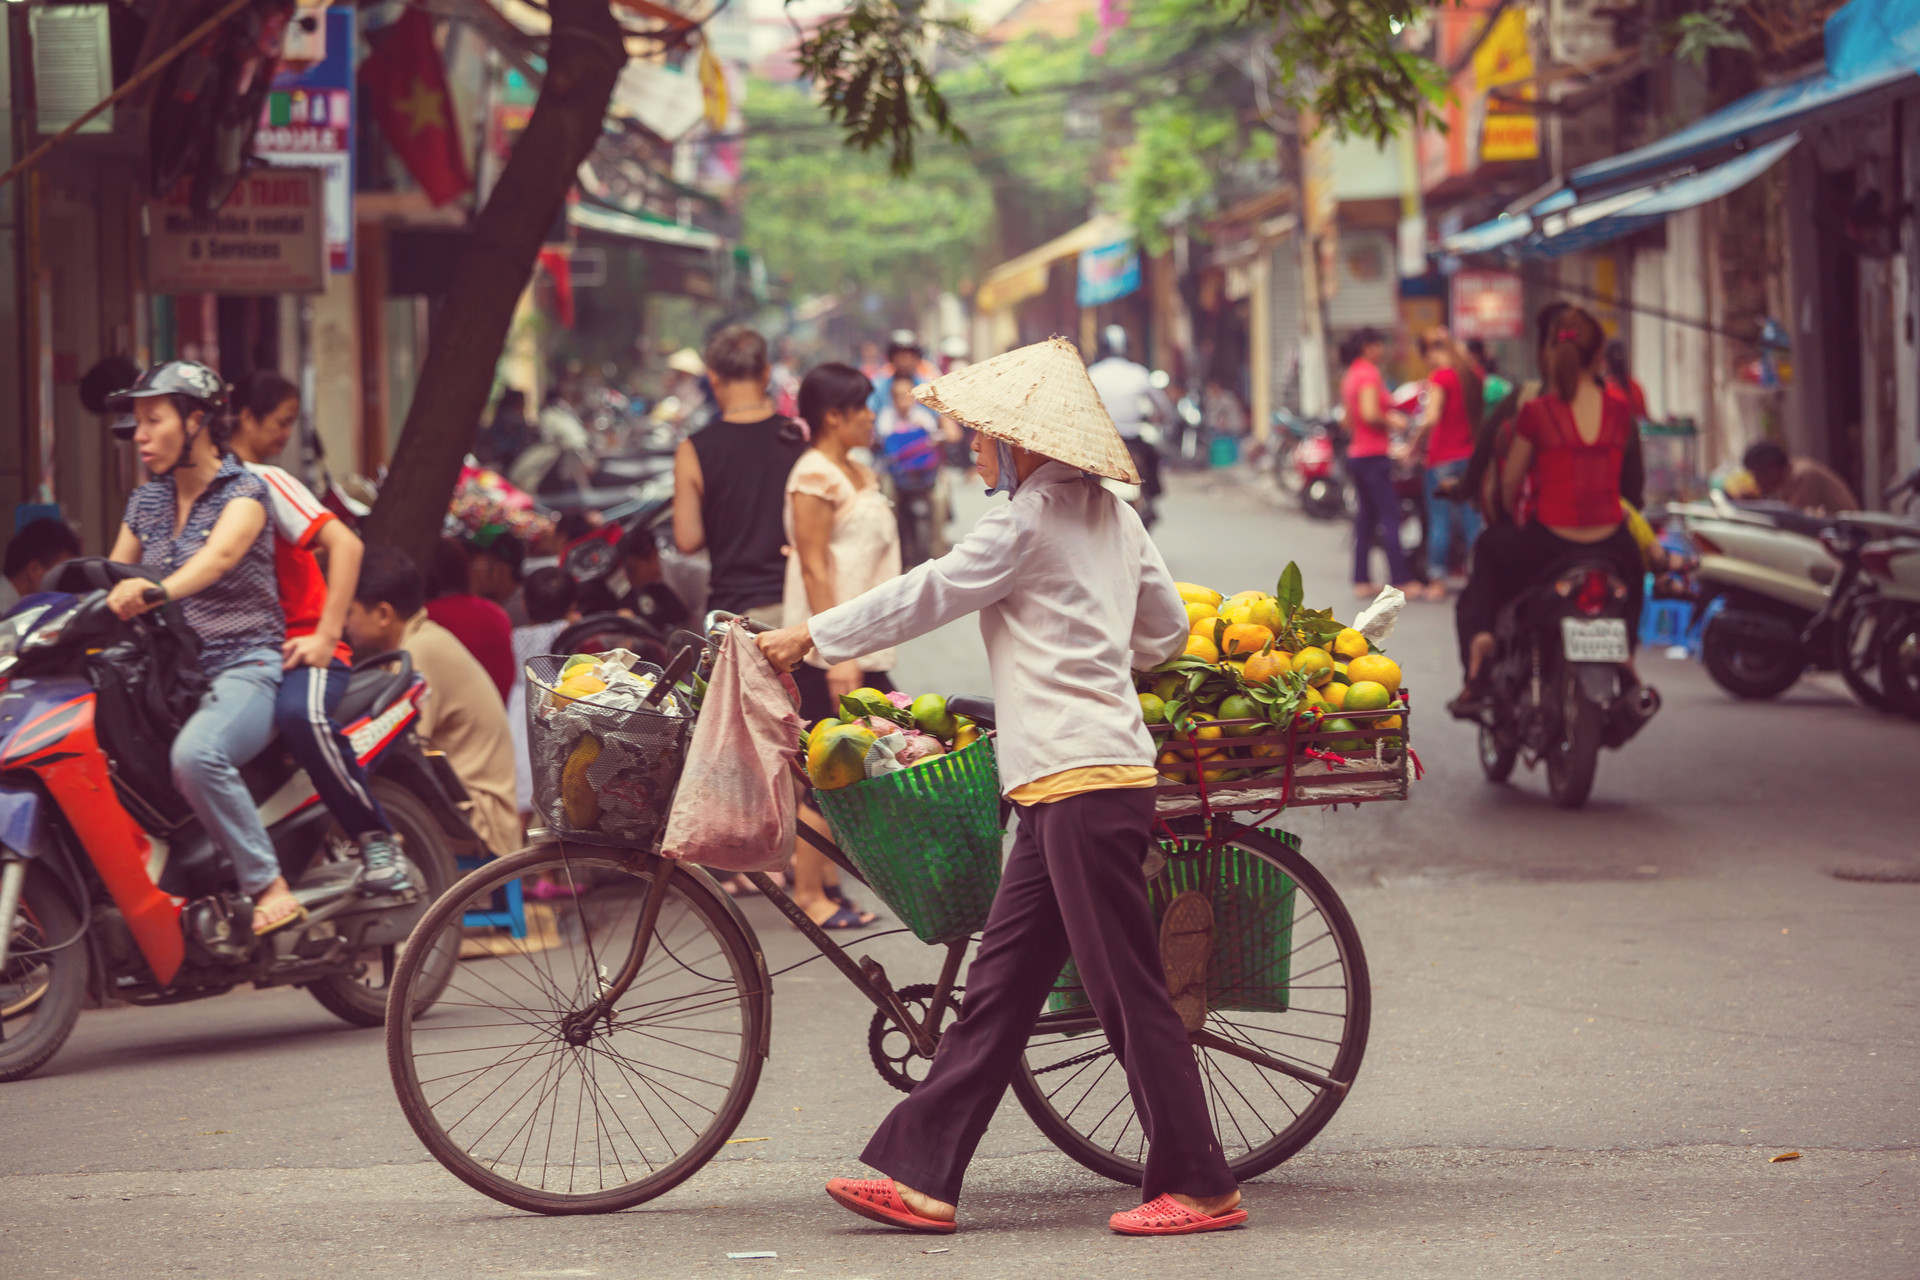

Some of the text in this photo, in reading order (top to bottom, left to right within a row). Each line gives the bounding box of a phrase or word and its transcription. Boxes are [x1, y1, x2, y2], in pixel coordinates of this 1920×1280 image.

[250, 179, 311, 207] TRAVEL
[256, 214, 304, 233] rental
[190, 239, 280, 259] & Services
